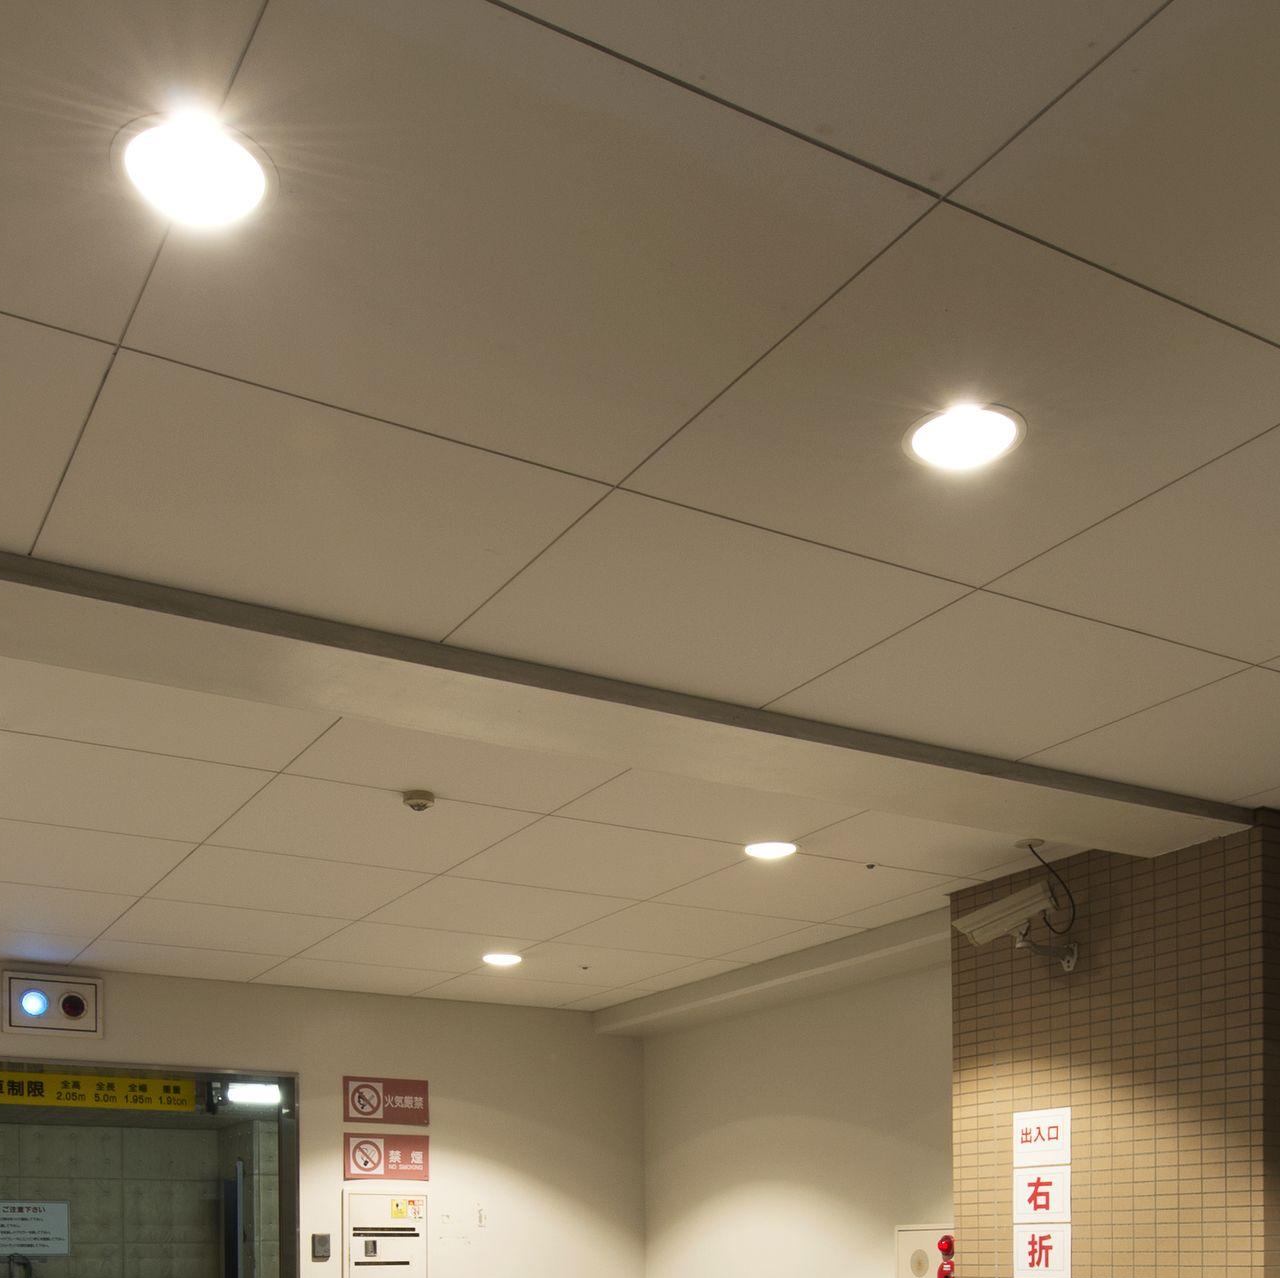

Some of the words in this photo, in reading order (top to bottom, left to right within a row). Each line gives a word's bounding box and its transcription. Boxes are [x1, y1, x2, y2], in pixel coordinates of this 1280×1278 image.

[56, 1091, 86, 1101] 2.05m
[94, 1093, 117, 1103] 5.0m
[124, 1095, 152, 1105] 1.95m
[159, 1096, 187, 1106] 1.9ton
[384, 1094, 424, 1110] 火気厳禁
[1020, 1125, 1059, 1144] 出入口
[389, 1150, 424, 1164] 禁煙
